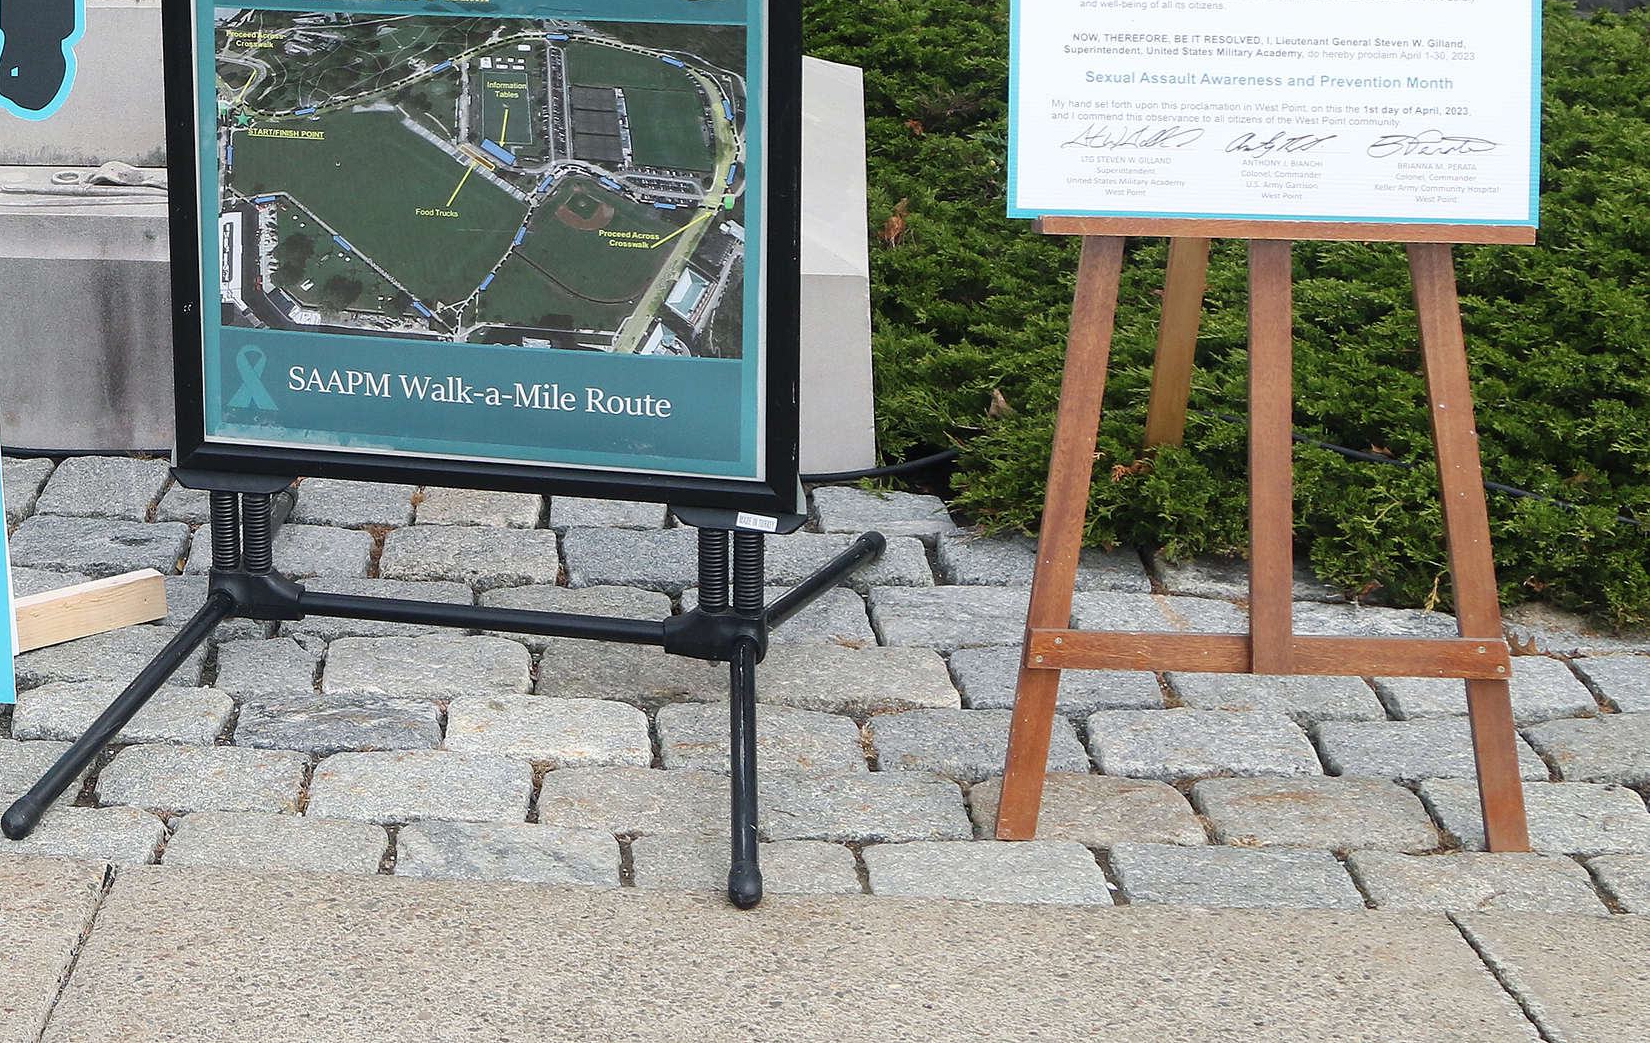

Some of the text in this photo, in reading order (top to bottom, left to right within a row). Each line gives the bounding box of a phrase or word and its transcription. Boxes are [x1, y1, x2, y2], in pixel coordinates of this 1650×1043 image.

[1174, 34, 1188, 44] BE
[1191, 34, 1200, 43] IT
[1275, 37, 1328, 45] Lieutenant
[1331, 37, 1371, 46] General
[1374, 38, 1408, 47] Steven
[1411, 39, 1423, 47] W.
[1085, 70, 1453, 89] Sexual Assault Awareness and Prevention Month
[486, 81, 528, 89] Information
[494, 90, 520, 98] Tables
[301, 131, 325, 140] POINT
[415, 208, 459, 218] Food Trucks
[598, 229, 660, 240] Proceed Across
[609, 239, 650, 248] Crosswalk
[288, 366, 672, 417] SAAPM Walk-a-Mile Route
